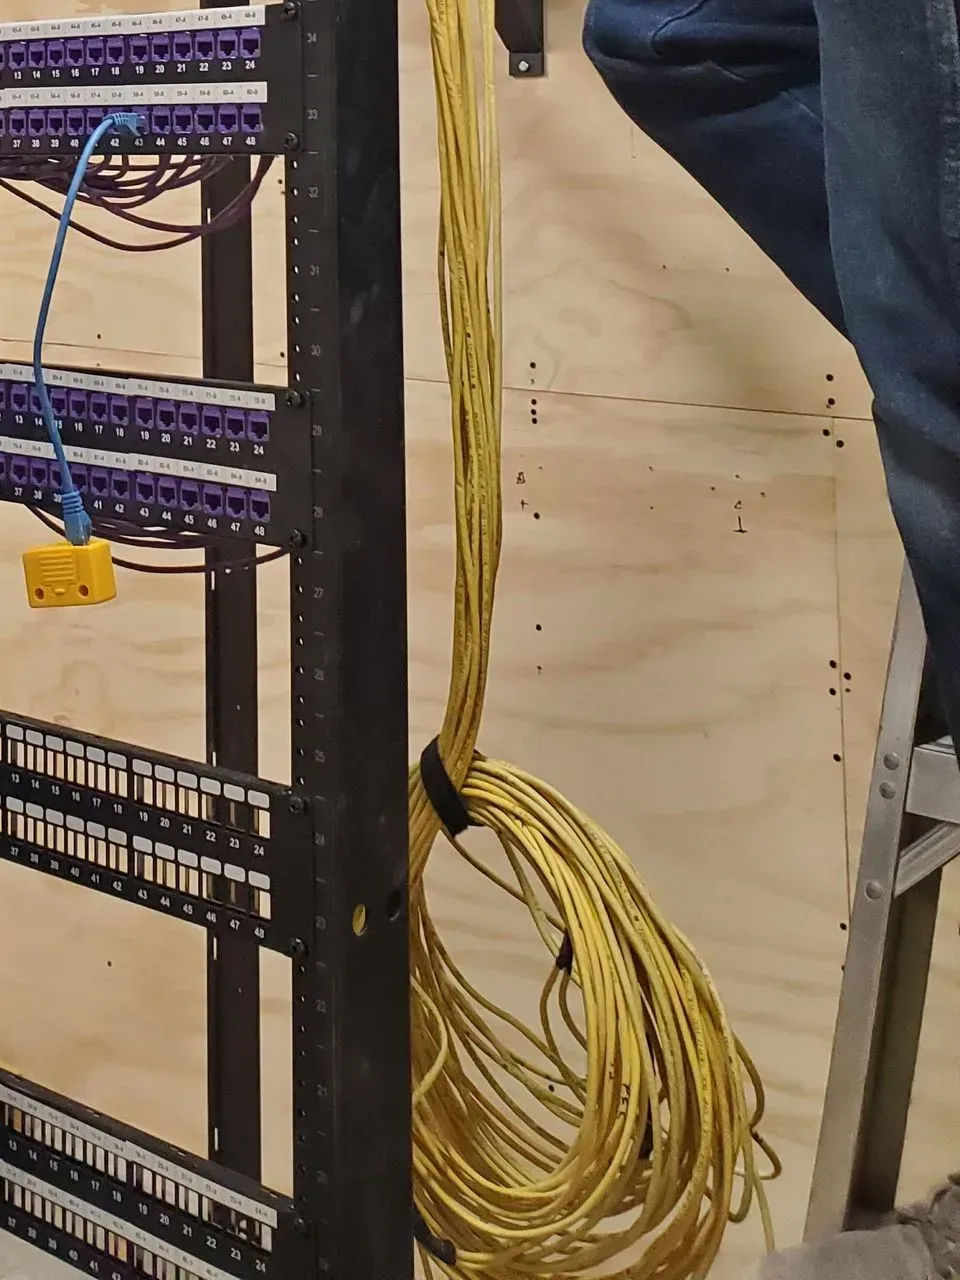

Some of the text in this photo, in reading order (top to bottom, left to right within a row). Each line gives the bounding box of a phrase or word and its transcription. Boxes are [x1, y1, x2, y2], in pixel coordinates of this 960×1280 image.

[306, 31, 318, 44] 34
[13, 70, 22, 80] 13
[32, 70, 41, 79] 14
[51, 69, 61, 78] 15
[70, 68, 80, 77] 16
[90, 67, 100, 77] 17
[111, 66, 120, 76] 18
[135, 65, 145, 74] 19
[154, 64, 165, 74] 20
[176, 63, 186, 73] 21
[199, 62, 209, 72] 22
[221, 61, 232, 71] 23
[245, 60, 256, 70] 24
[306, 108, 319, 121] 33
[12, 136, 256, 148] 37 38 39 40 42 43 44 45 46 47 48
[307, 186, 320, 199] 32
[15, 414, 24, 424] 13
[34, 417, 43, 426] 14
[74, 422, 83, 432] 16
[94, 424, 104, 434] 17
[115, 427, 125, 438] 18
[140, 430, 150, 441] 19
[161, 432, 171, 444] 20
[183, 435, 193, 446] 21
[206, 438, 217, 449] 22
[229, 441, 240, 452] 23
[253, 444, 265, 455] 24
[93, 499, 265, 537] 41 42 43 44 45 46 47 48
[11, 772, 20, 784] 13
[31, 779, 40, 789] 14
[51, 784, 60, 796] 15
[71, 791, 81, 802] 16
[92, 797, 102, 808] 17
[113, 803, 123, 815] 18
[139, 811, 149, 822] 19
[159, 816, 170, 828] 20
[182, 823, 192, 835] 21
[205, 830, 217, 842] 22
[229, 837, 240, 849] 23
[253, 844, 265, 856] 24
[90, 873, 265, 939] 41 42 43 44 45 46 47 48
